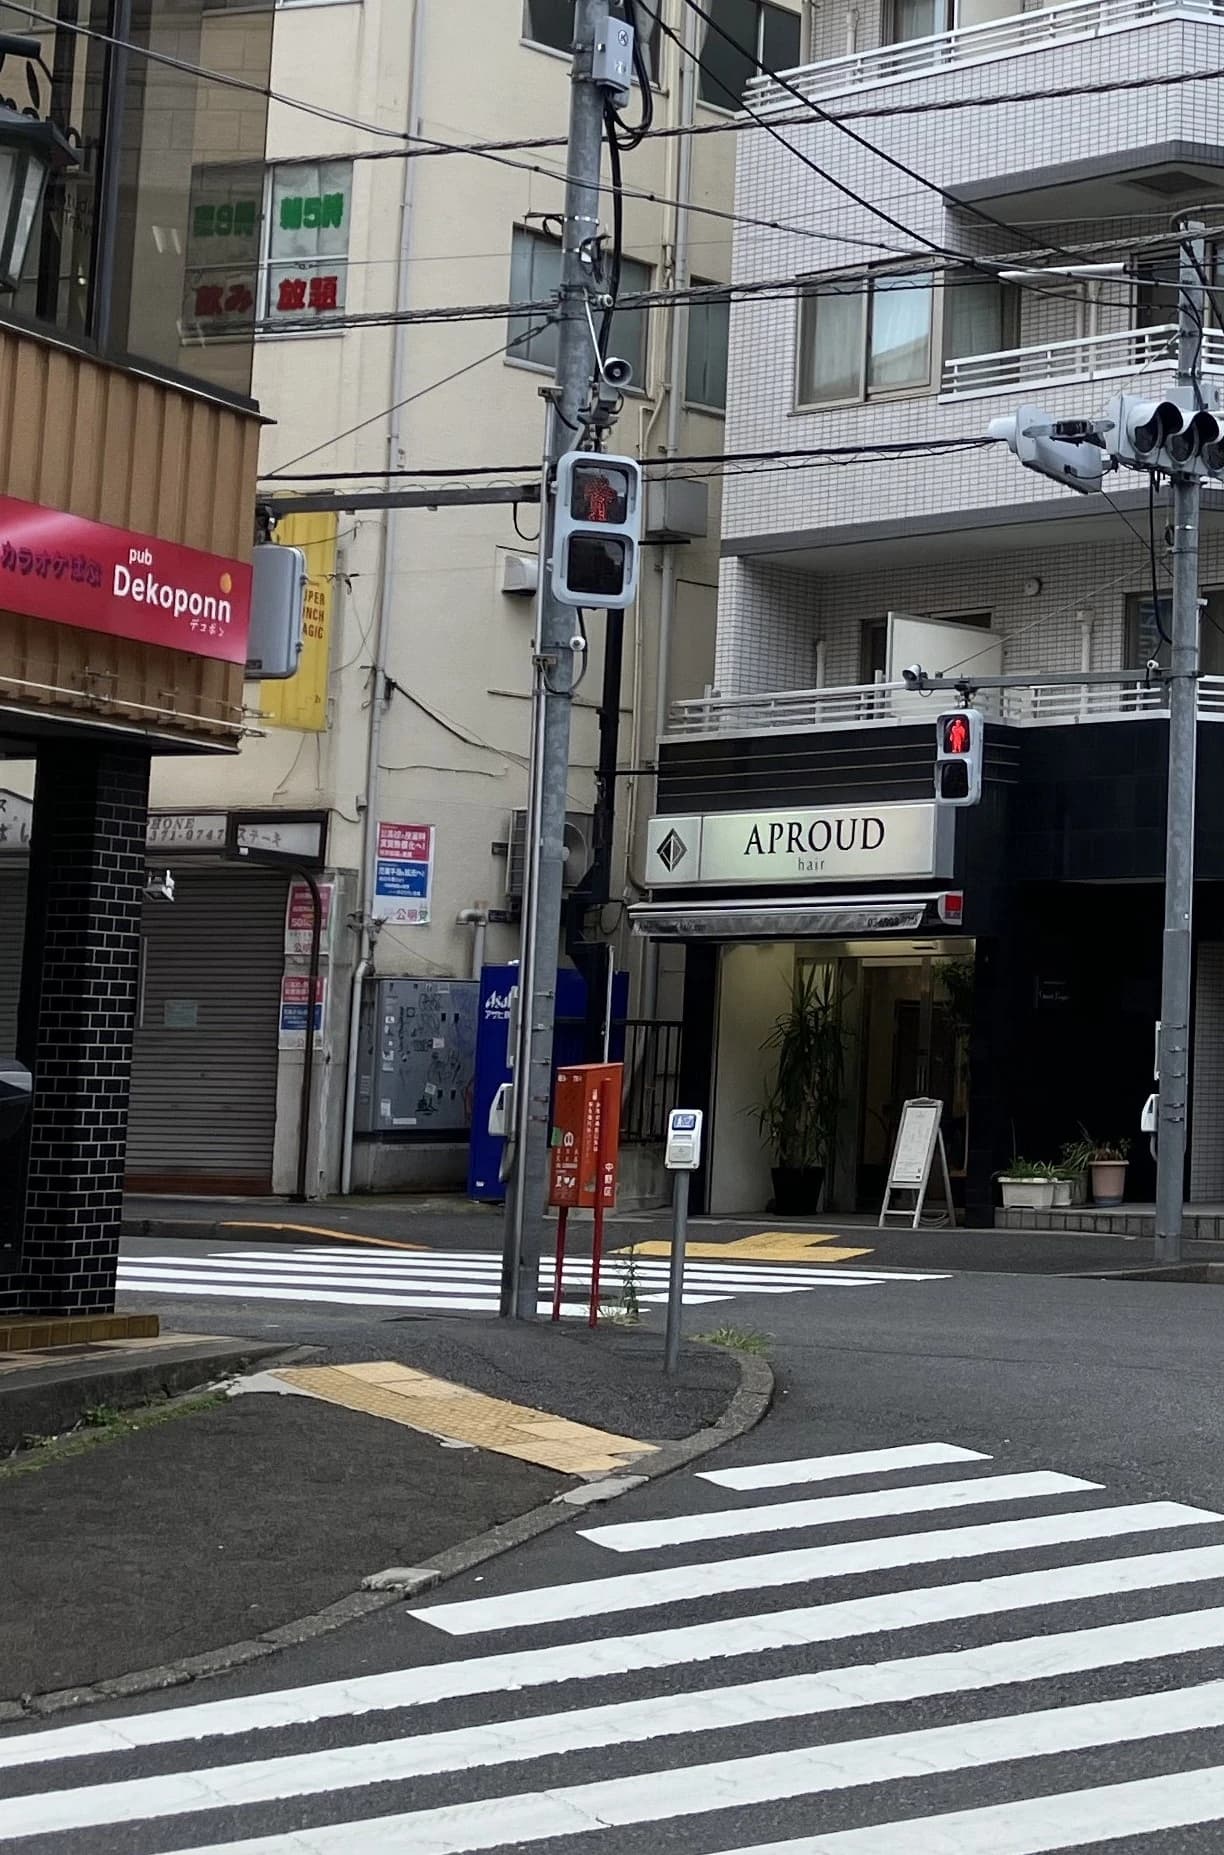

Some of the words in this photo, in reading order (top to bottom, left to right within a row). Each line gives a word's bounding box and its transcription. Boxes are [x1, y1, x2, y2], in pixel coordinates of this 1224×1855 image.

[128, 547, 153, 566] pub
[113, 564, 232, 624] Dekoponn
[744, 817, 885, 855] APROUD
[797, 858, 825, 871] hair
